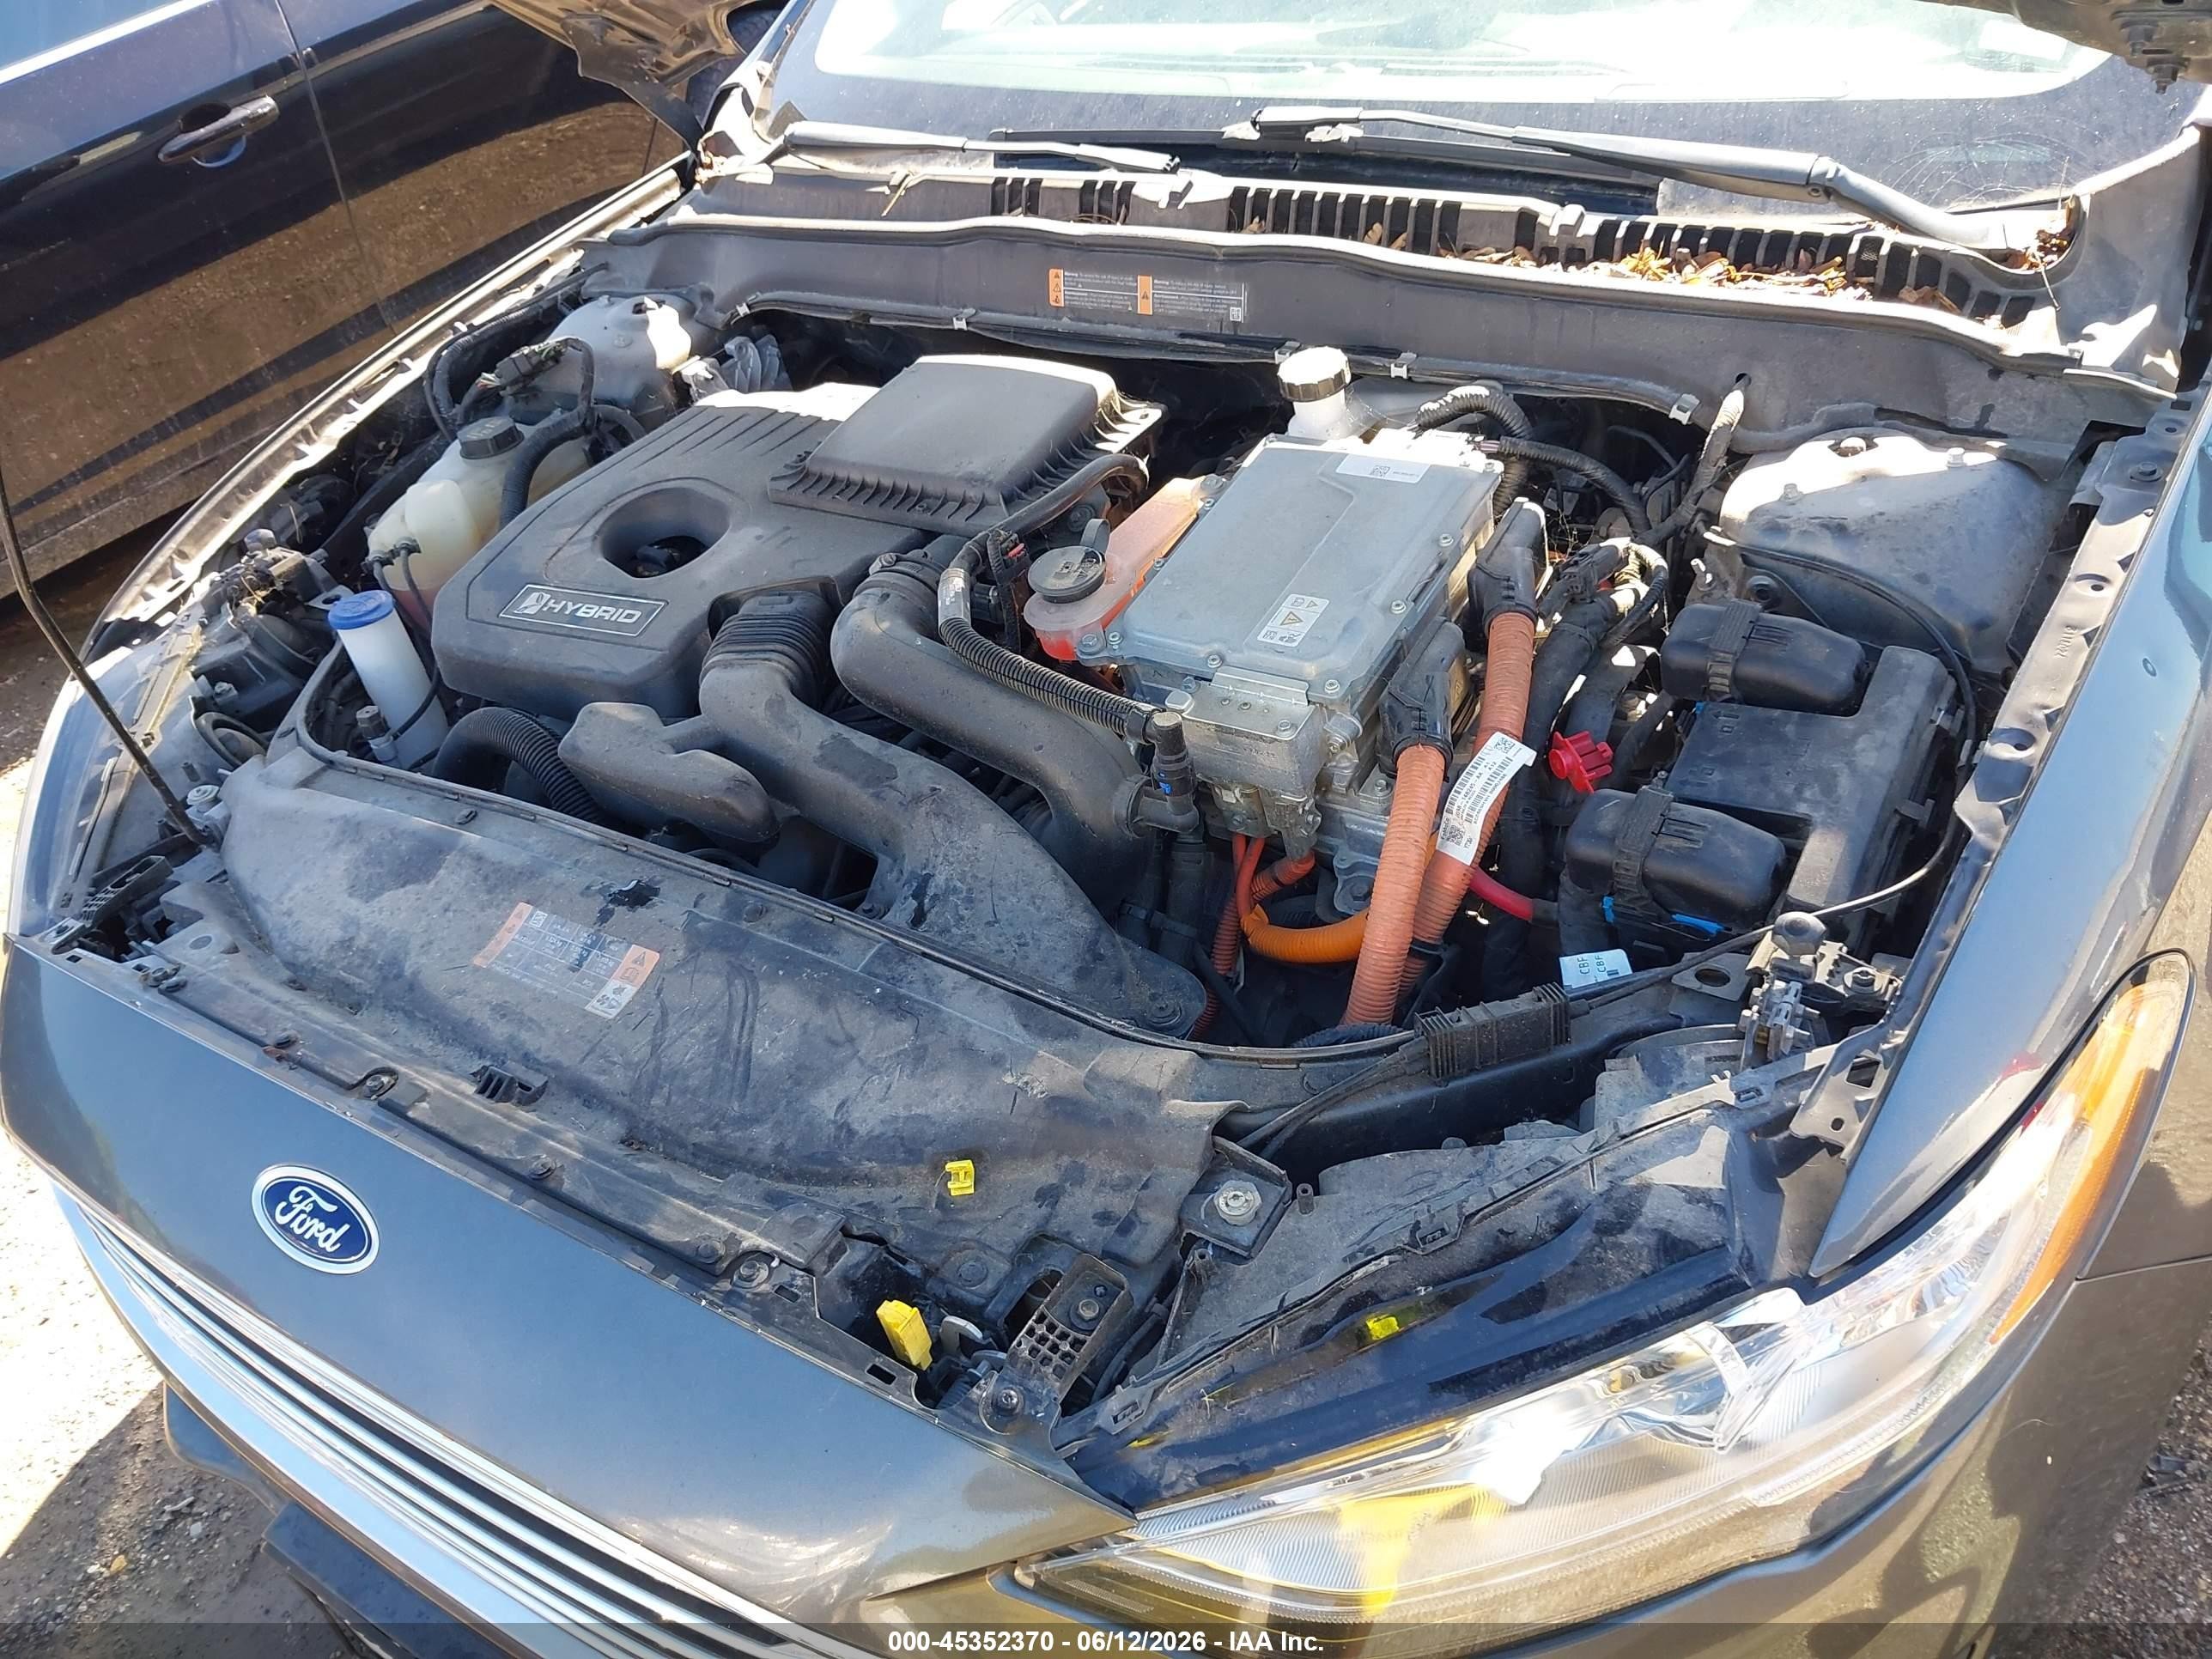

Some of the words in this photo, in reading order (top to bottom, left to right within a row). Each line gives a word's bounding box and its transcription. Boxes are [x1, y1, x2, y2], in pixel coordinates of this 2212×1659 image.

[542, 599, 642, 623] HYBRID
[1577, 957, 1590, 975] CBF
[1595, 955, 1607, 973] CBF
[275, 1186, 350, 1253] Ford
